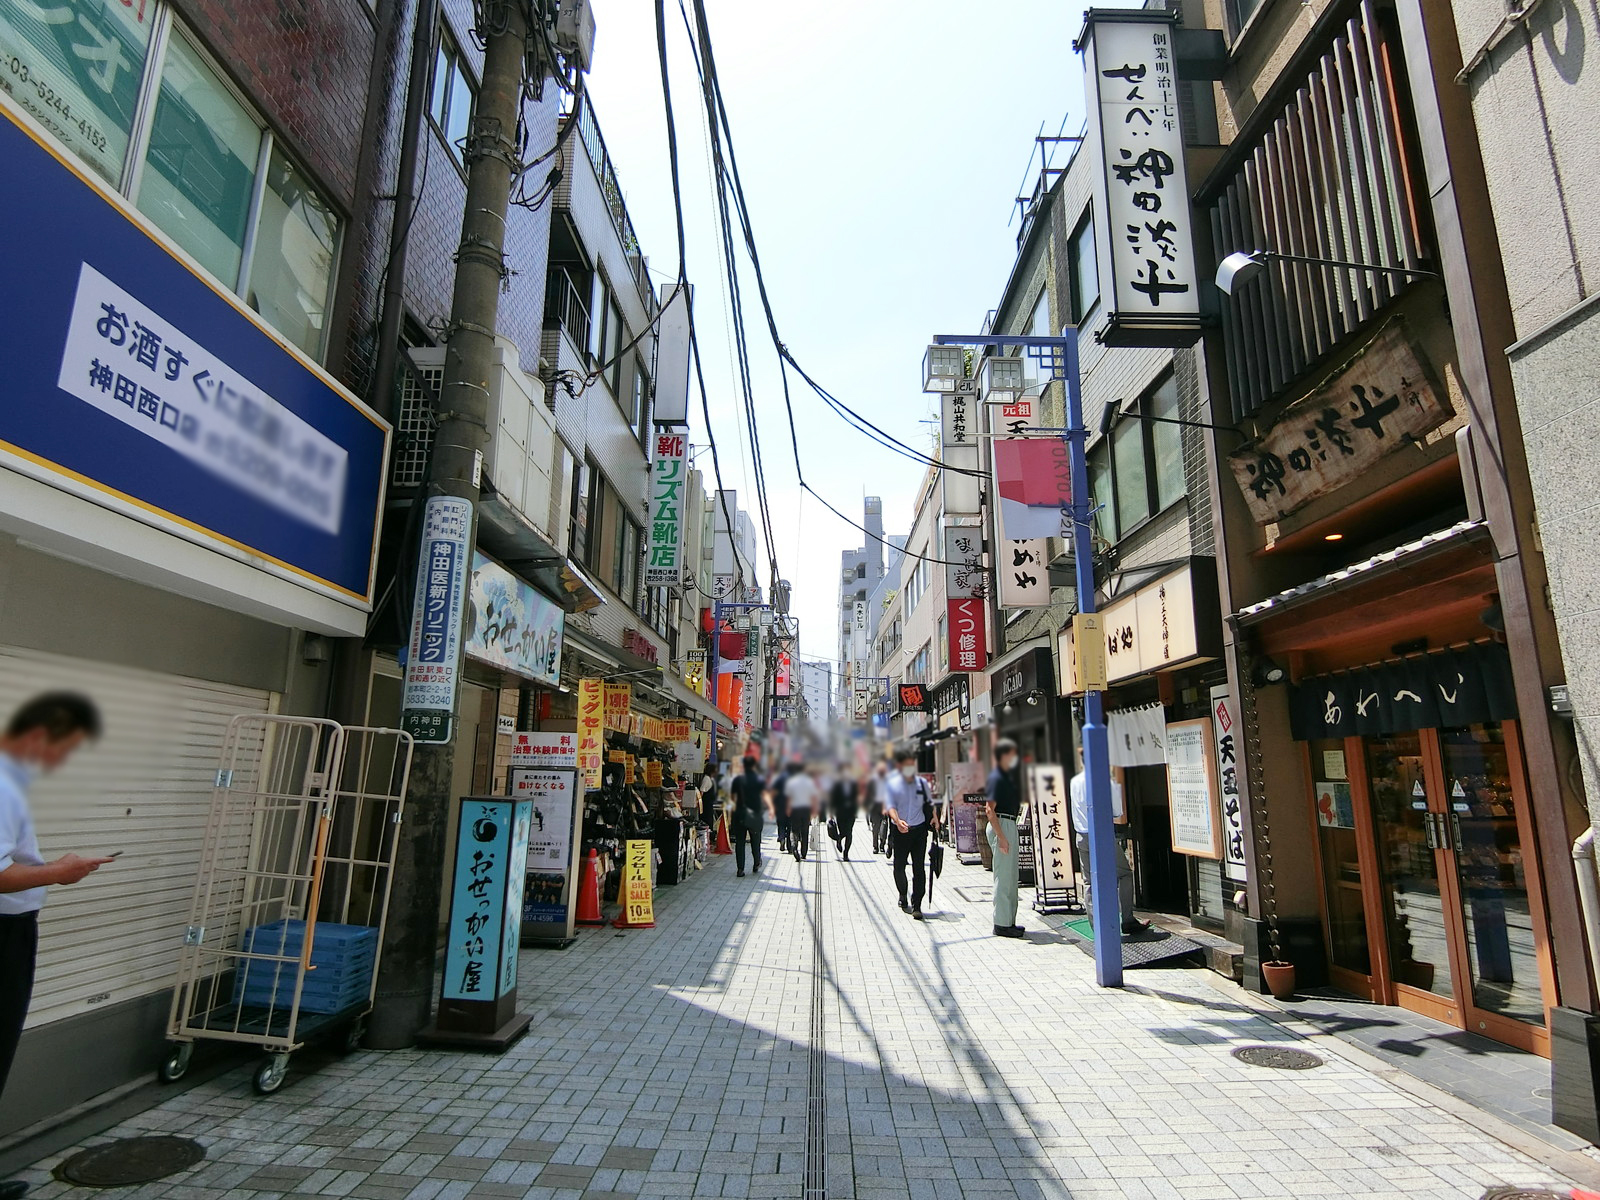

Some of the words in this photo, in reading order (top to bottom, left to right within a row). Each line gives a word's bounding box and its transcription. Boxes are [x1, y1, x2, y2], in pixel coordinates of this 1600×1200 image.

[1152, 32, 1176, 132] 創業明治十七年
[952, 396, 966, 443] 梶山共和堂
[1004, 404, 1030, 416] 元祖
[657, 436, 683, 457] 靴
[1051, 437, 1070, 492] TOKYO
[649, 460, 682, 567] リズム靴店
[1012, 539, 1037, 589] めや
[424, 542, 452, 661] 神田医新クリニック
[958, 600, 977, 668] くつ修理
[410, 716, 442, 726] 内神田
[413, 727, 436, 737] 2-9
[513, 745, 575, 755] 治療体験開催中
[1220, 734, 1245, 861] 天玉そば
[630, 890, 650, 900] SALE
[630, 905, 643, 916] 10
[459, 849, 495, 994] おせっかい屋
